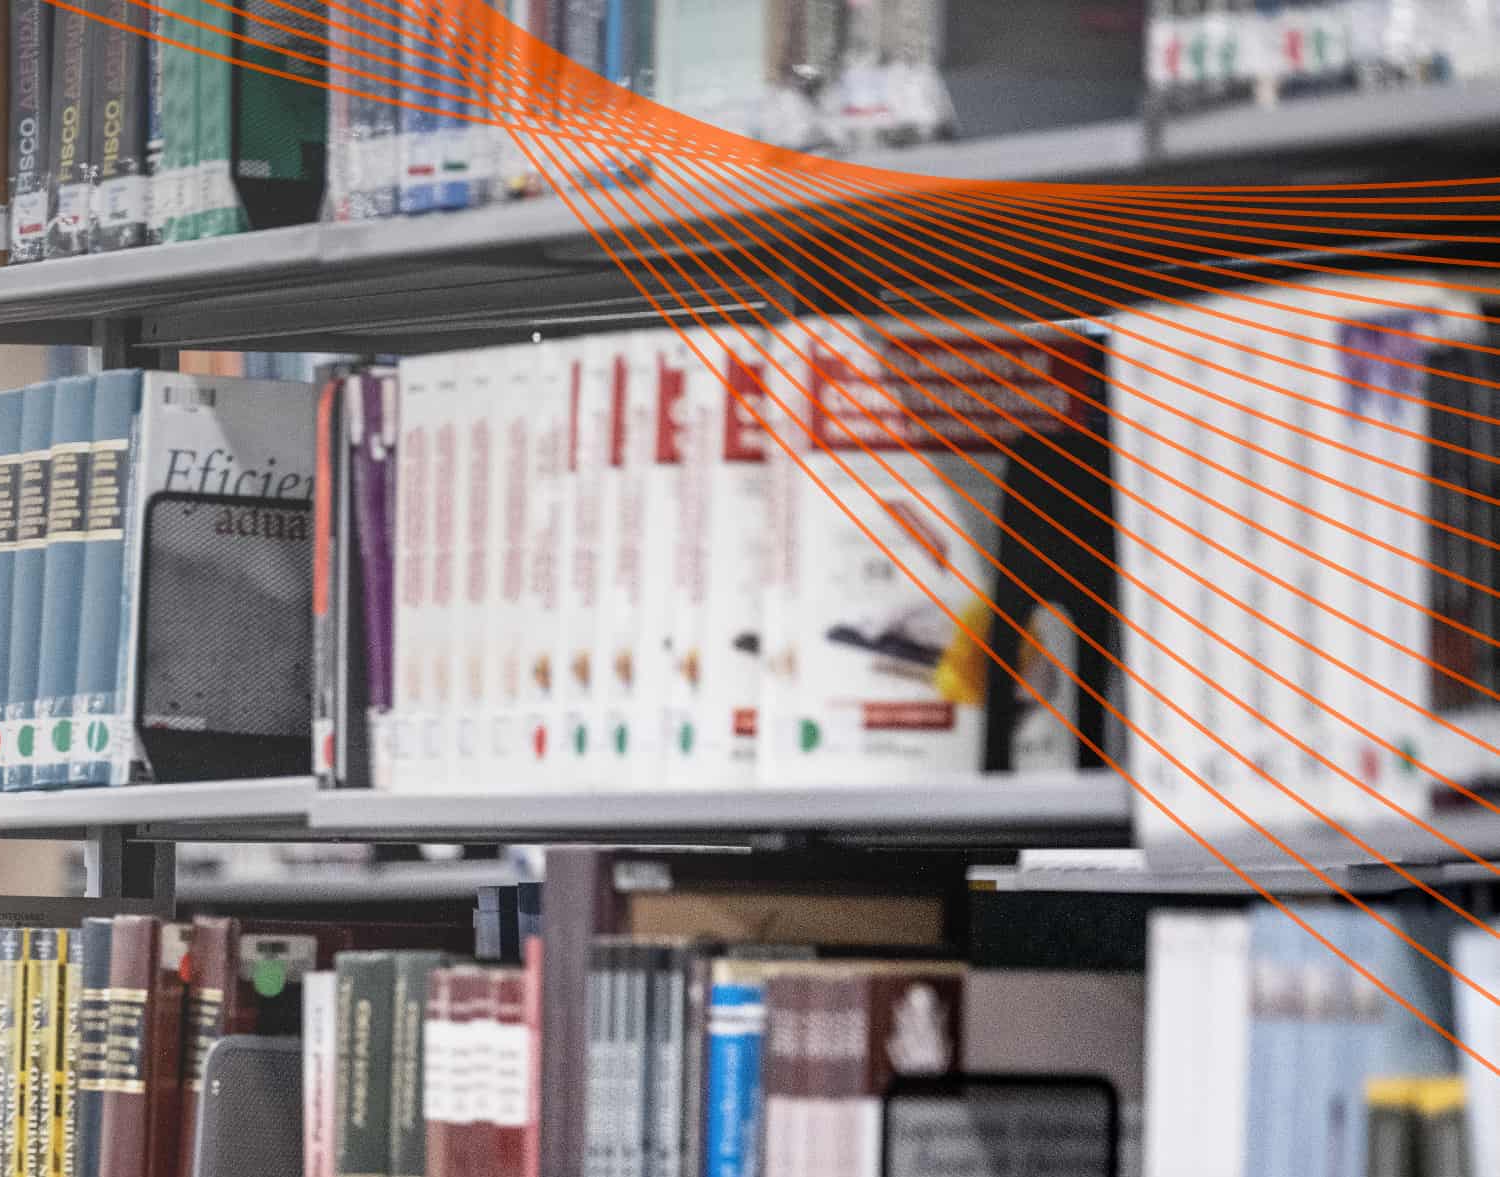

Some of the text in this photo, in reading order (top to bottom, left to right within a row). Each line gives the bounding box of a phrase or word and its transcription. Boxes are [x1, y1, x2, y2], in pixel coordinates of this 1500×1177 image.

[19, 8, 37, 191] FISCO AGENDA
[103, 99, 120, 175] FISCO
[57, 106, 77, 181] FISCO
